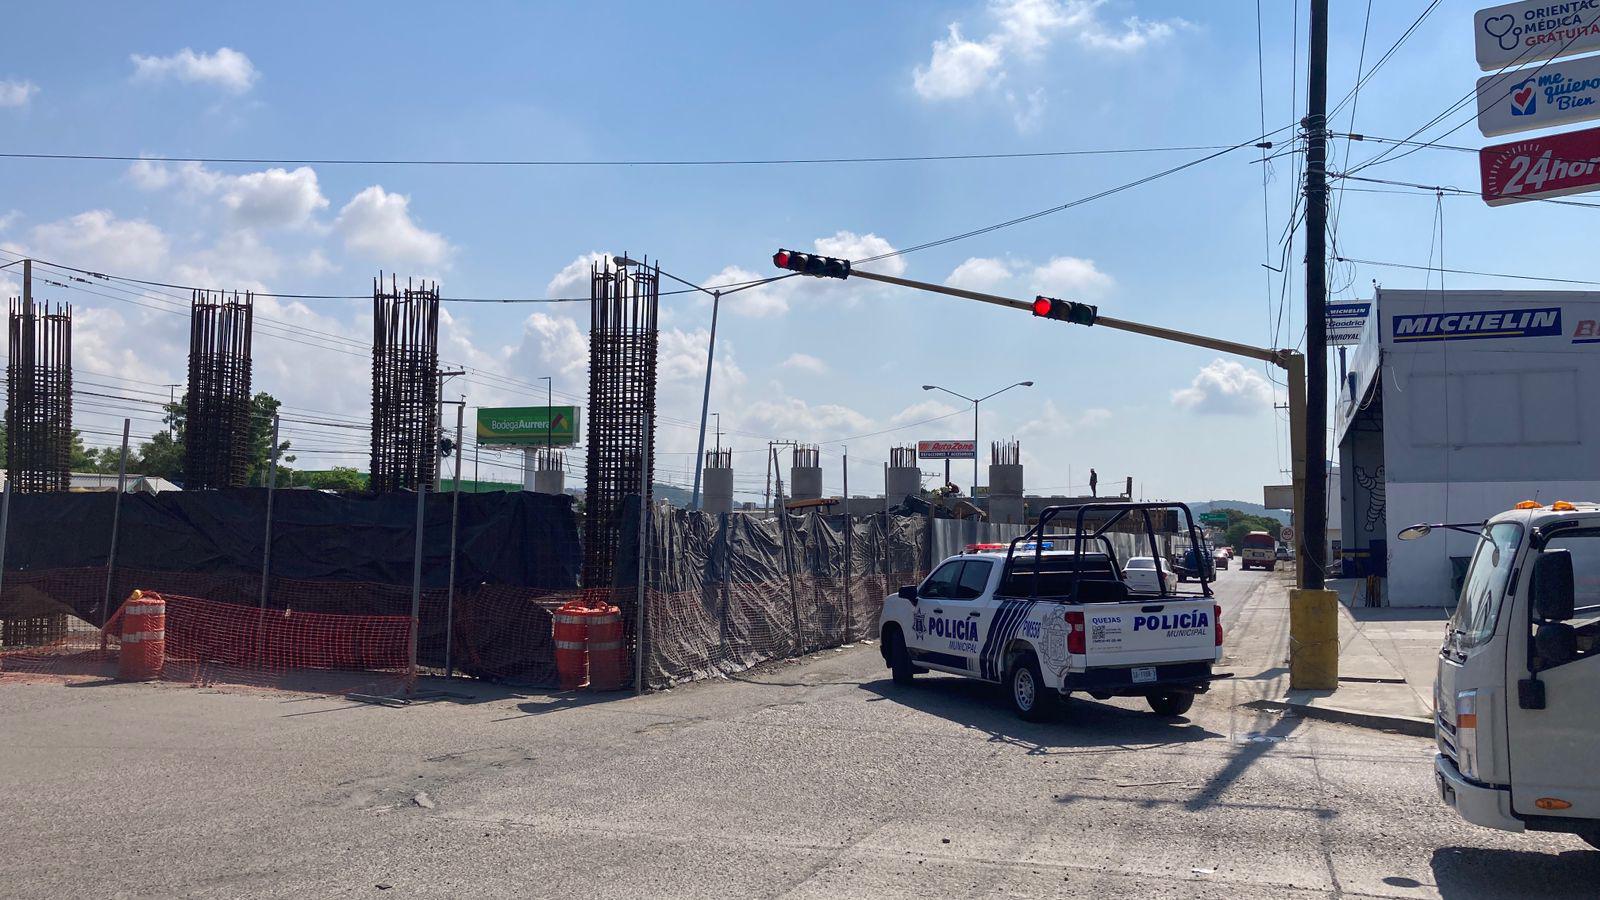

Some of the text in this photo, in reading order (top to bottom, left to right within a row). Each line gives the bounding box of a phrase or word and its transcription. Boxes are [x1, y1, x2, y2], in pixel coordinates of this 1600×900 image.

[1524, 14, 1582, 34] MÉDICA
[1525, 23, 1600, 46] GRATUITA
[1538, 73, 1564, 87] me
[1544, 78, 1600, 104] quiero
[1556, 96, 1595, 110] Bien
[1396, 311, 1558, 335] MICHELIN
[1573, 320, 1600, 337] B
[932, 442, 974, 450] AutoZone
[1092, 616, 1121, 625] QUEJAS
[1134, 609, 1208, 631] POLICÍA
[928, 616, 979, 642] POLICÍA
[1166, 629, 1207, 638] MUNICIPAL
[949, 641, 977, 654] MUNICIPAL
